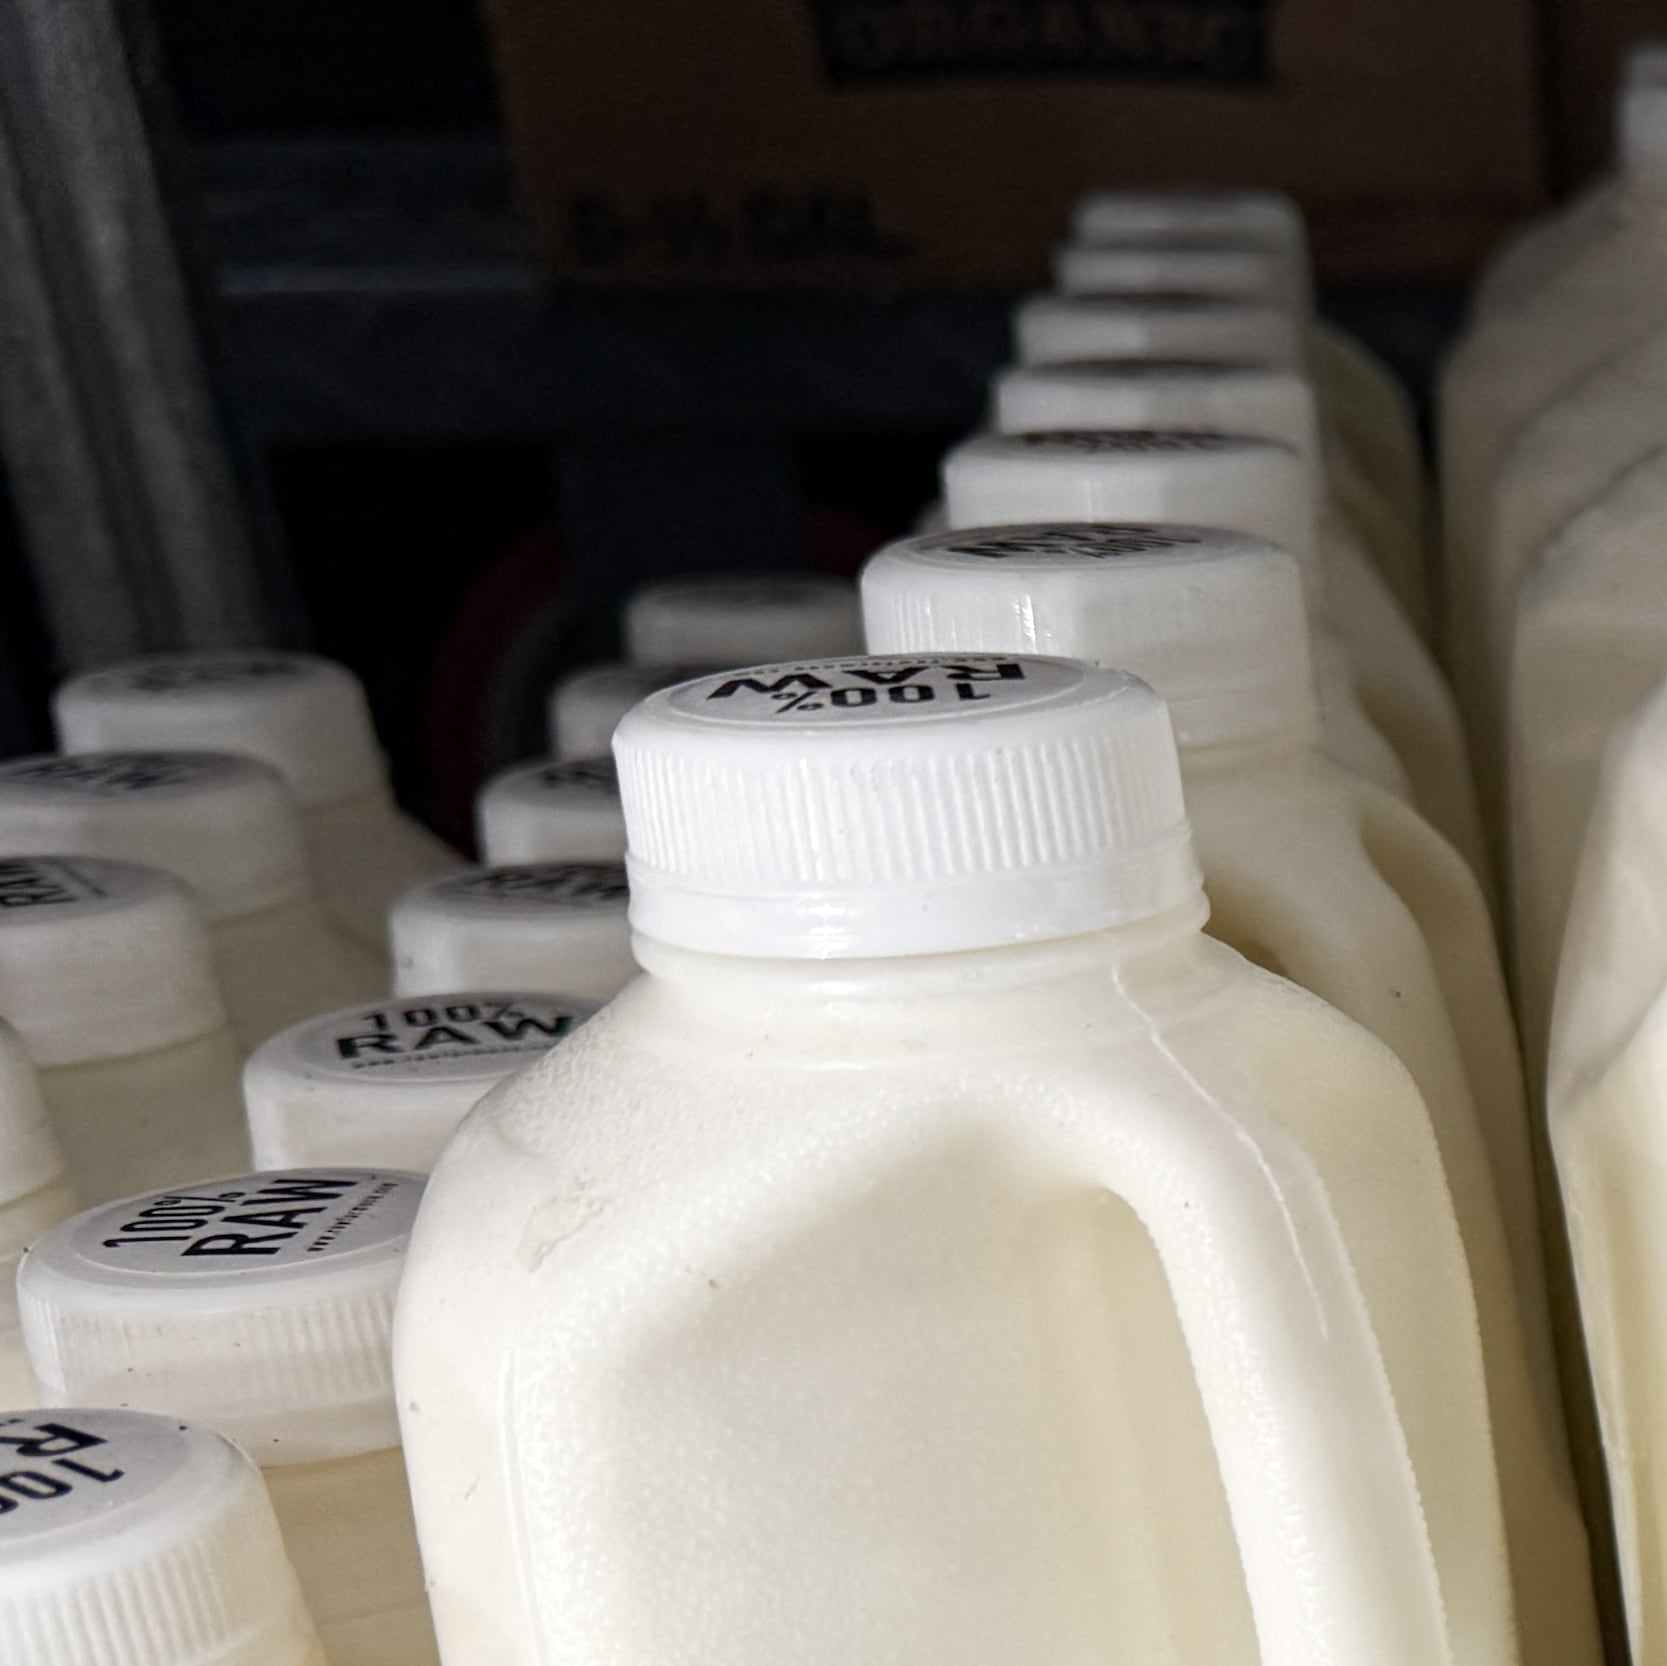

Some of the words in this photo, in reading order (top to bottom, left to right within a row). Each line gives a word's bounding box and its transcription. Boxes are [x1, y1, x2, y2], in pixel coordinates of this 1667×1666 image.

[706, 662, 1027, 701] RAW
[774, 682, 992, 715] 100%
[360, 1000, 527, 1032] 100%
[336, 1015, 574, 1060] RAW
[102, 1191, 246, 1249] 100%
[180, 1178, 359, 1257] RAW
